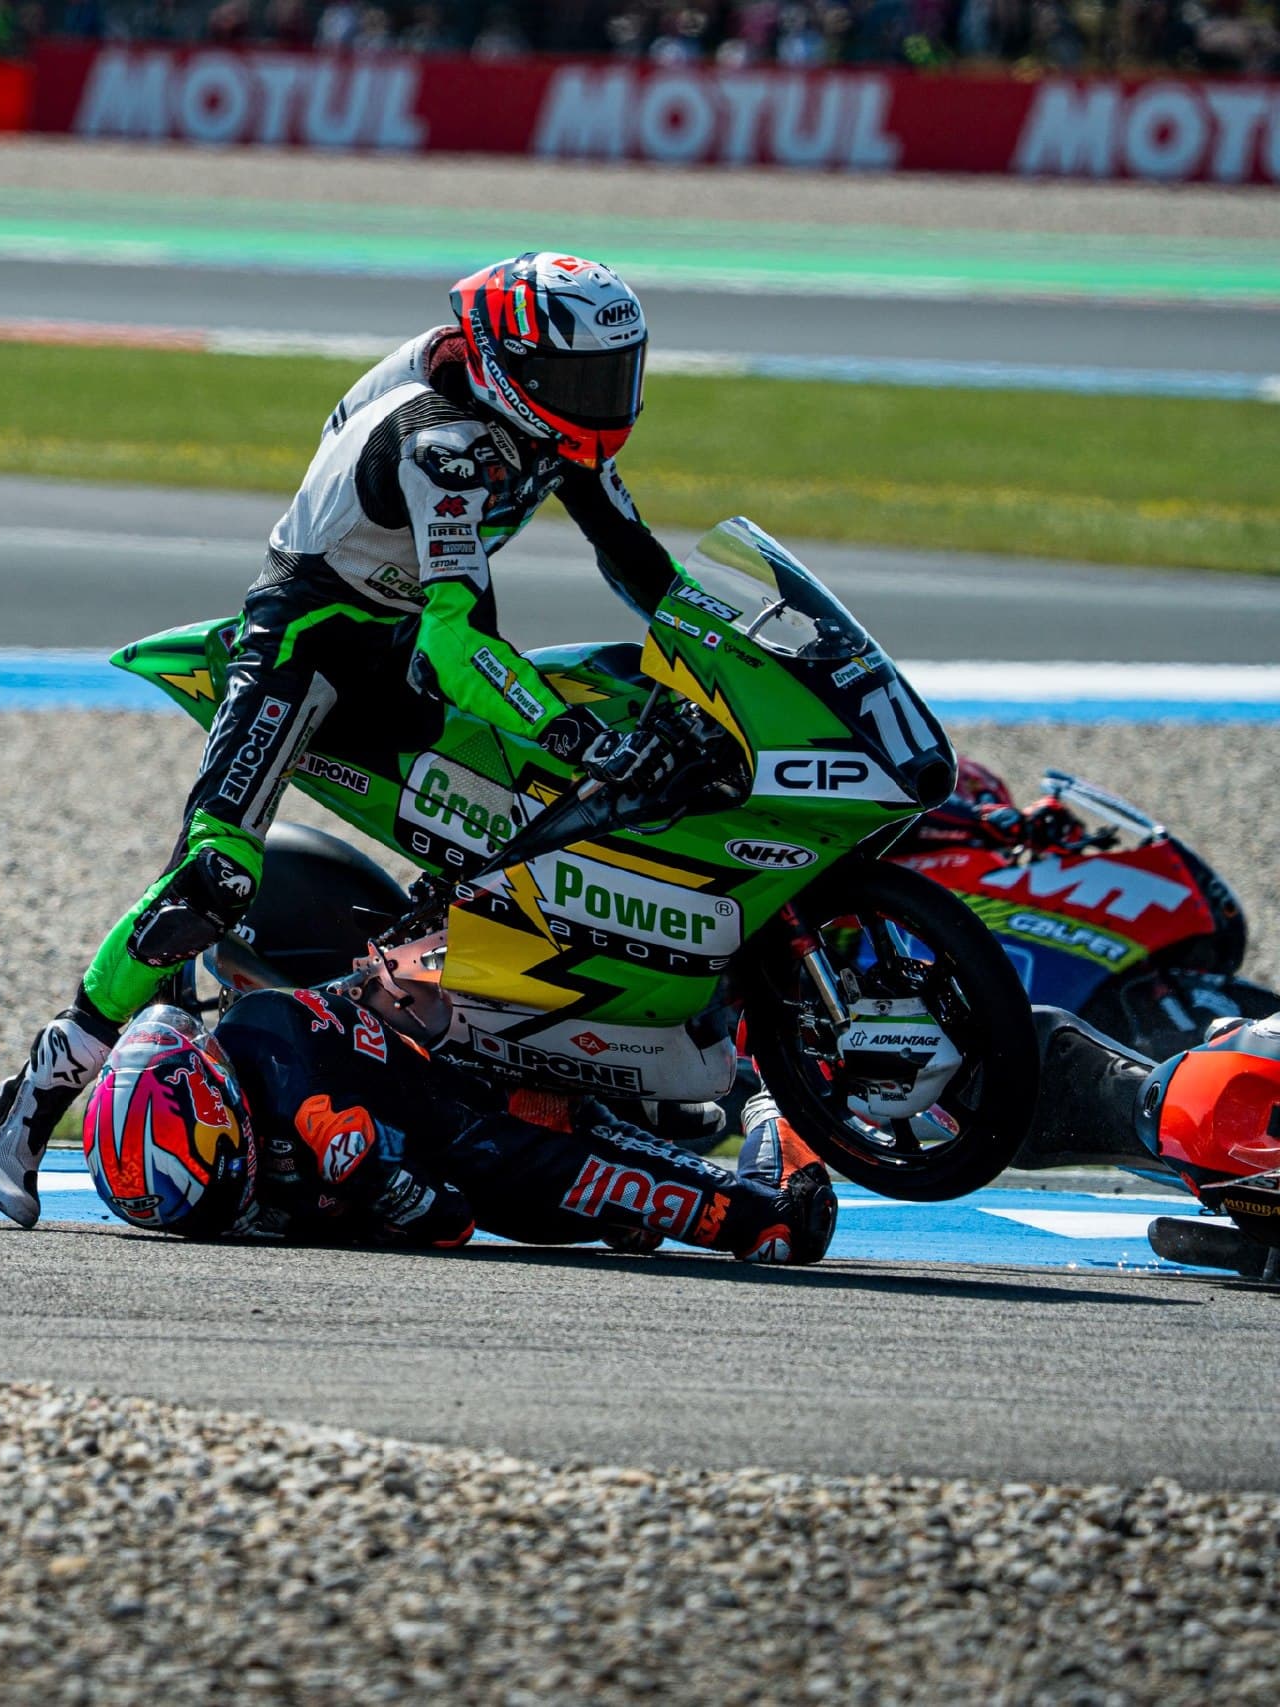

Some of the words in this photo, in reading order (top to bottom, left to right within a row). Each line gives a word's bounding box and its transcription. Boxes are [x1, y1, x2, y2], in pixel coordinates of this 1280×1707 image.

[74, 50, 428, 149] MOTUL
[533, 66, 902, 167] MOTUL
[1010, 82, 1280, 180] MOT
[601, 302, 637, 326] NHK
[380, 566, 422, 597] Gree
[477, 649, 503, 679] Green
[511, 687, 539, 715] Power
[218, 717, 281, 806] IPONE
[307, 755, 369, 795] IPONE
[774, 759, 869, 791] CIP
[414, 768, 520, 842] Gree
[736, 843, 805, 865] NHK
[554, 860, 716, 944] Power
[353, 1008, 387, 1064] Re
[607, 1042, 665, 1055] GROUP
[870, 1035, 941, 1046] ADVANTAGE
[507, 1040, 641, 1093] IPONE
[561, 1155, 702, 1238] Bull
[1224, 1198, 1280, 1216] MOTOR
